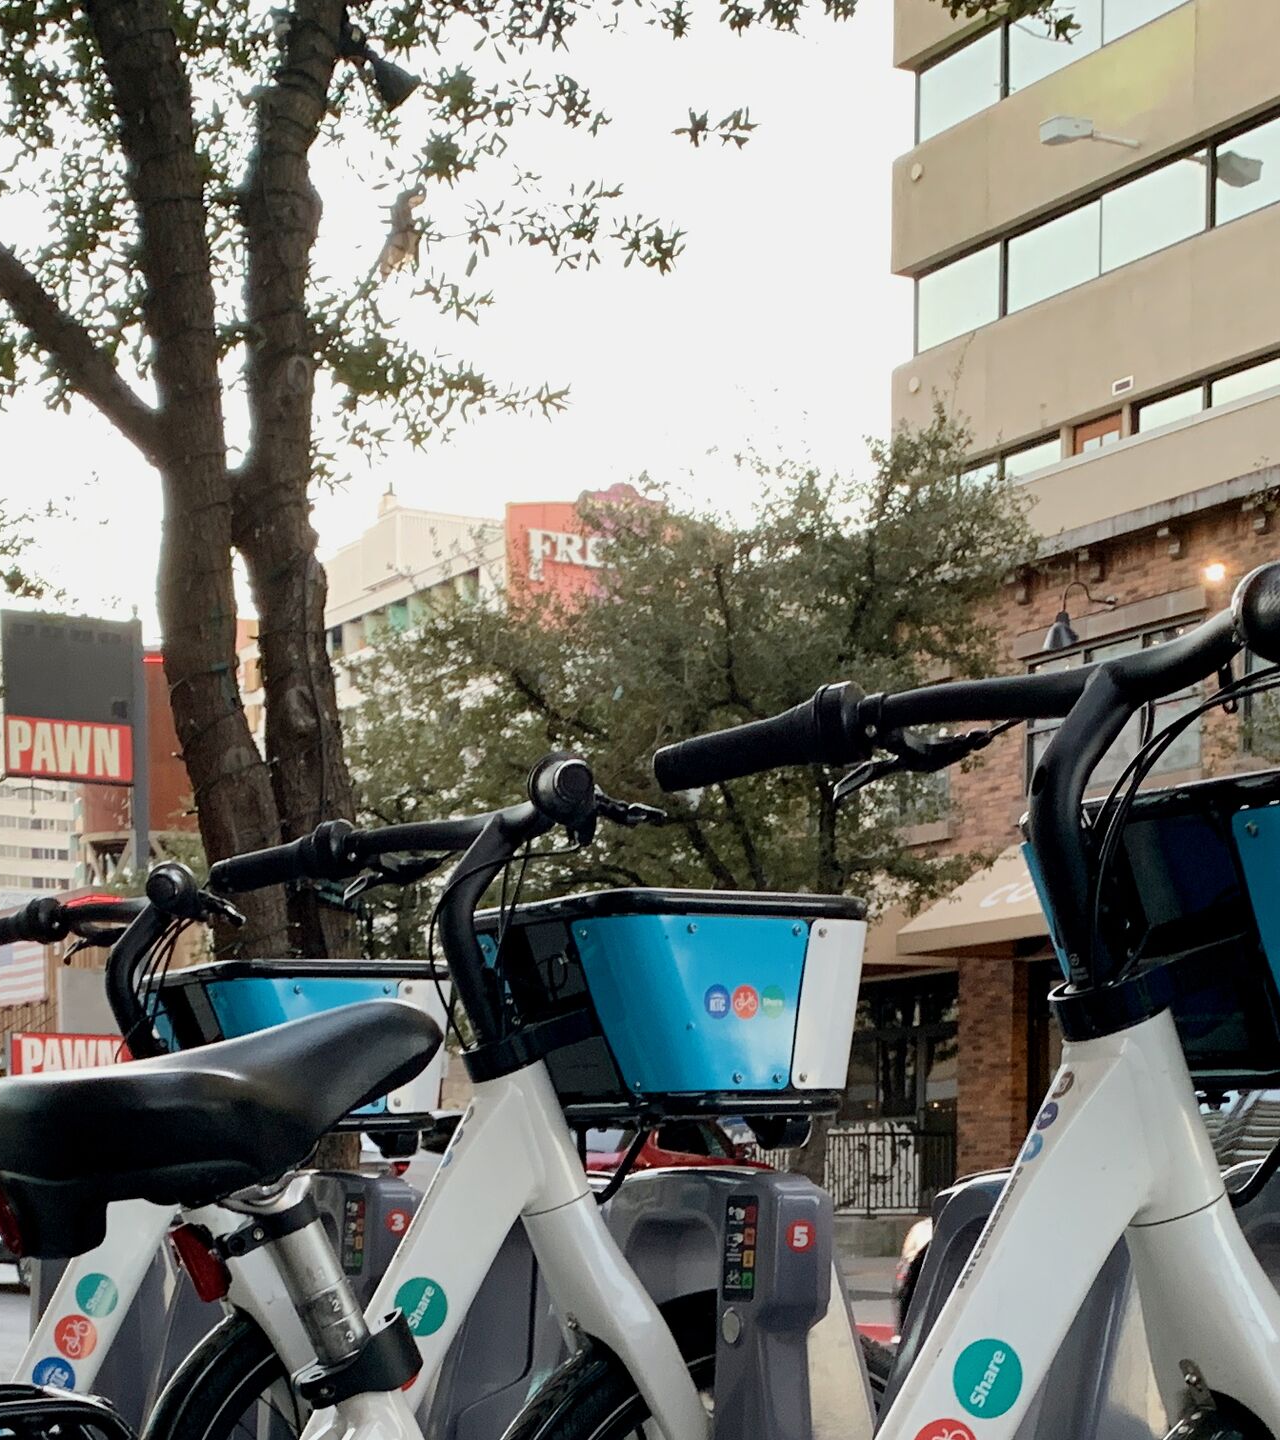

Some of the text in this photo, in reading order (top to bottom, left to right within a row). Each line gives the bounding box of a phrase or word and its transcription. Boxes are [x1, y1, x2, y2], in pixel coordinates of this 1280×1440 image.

[7, 719, 120, 777] PAWN
[21, 1037, 122, 1076] PAWN
[391, 1213, 405, 1231] 3
[793, 1225, 809, 1248] 5
[407, 1285, 436, 1329] Share
[345, 1330, 356, 1343] 3
[969, 1350, 1006, 1408] Share
